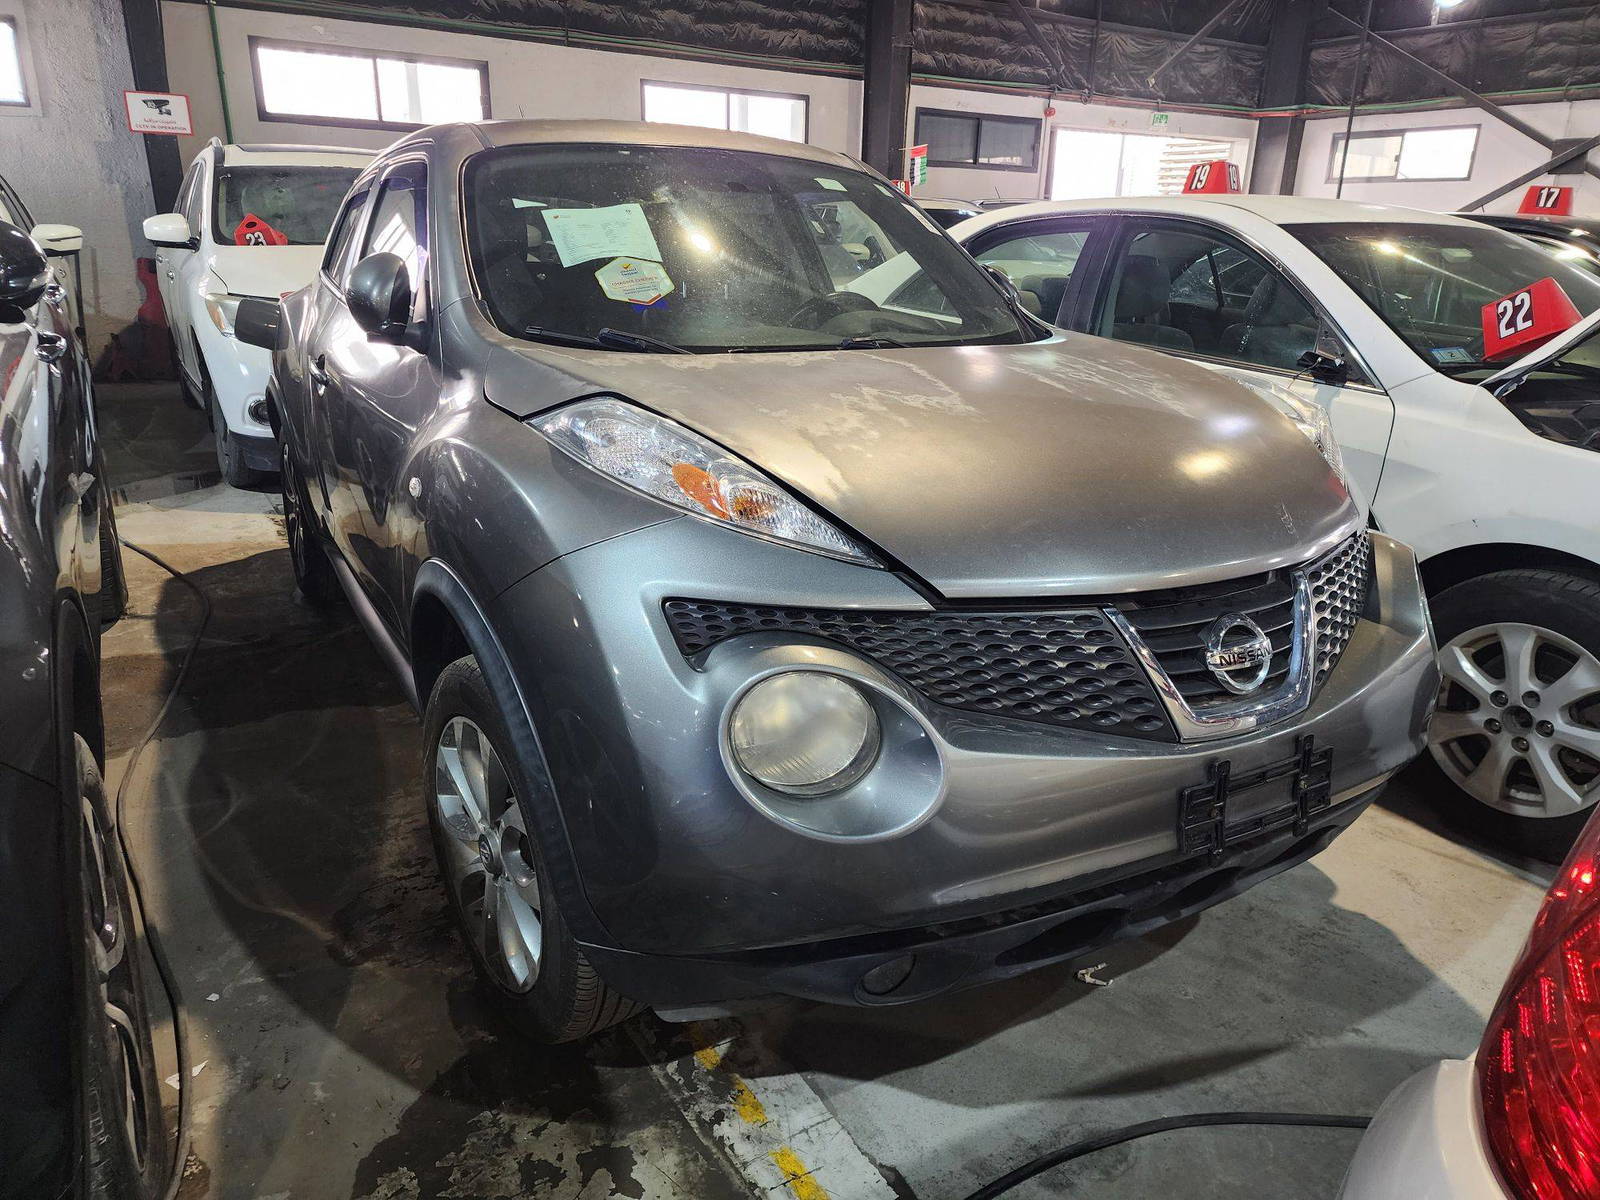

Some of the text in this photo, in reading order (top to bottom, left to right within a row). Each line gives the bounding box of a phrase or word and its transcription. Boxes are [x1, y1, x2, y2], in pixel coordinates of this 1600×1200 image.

[1190, 165, 1211, 190] 19
[1538, 187, 1560, 208] 17
[245, 231, 267, 246] 23
[1498, 291, 1533, 339] 22
[1218, 645, 1271, 667] NISSAN
